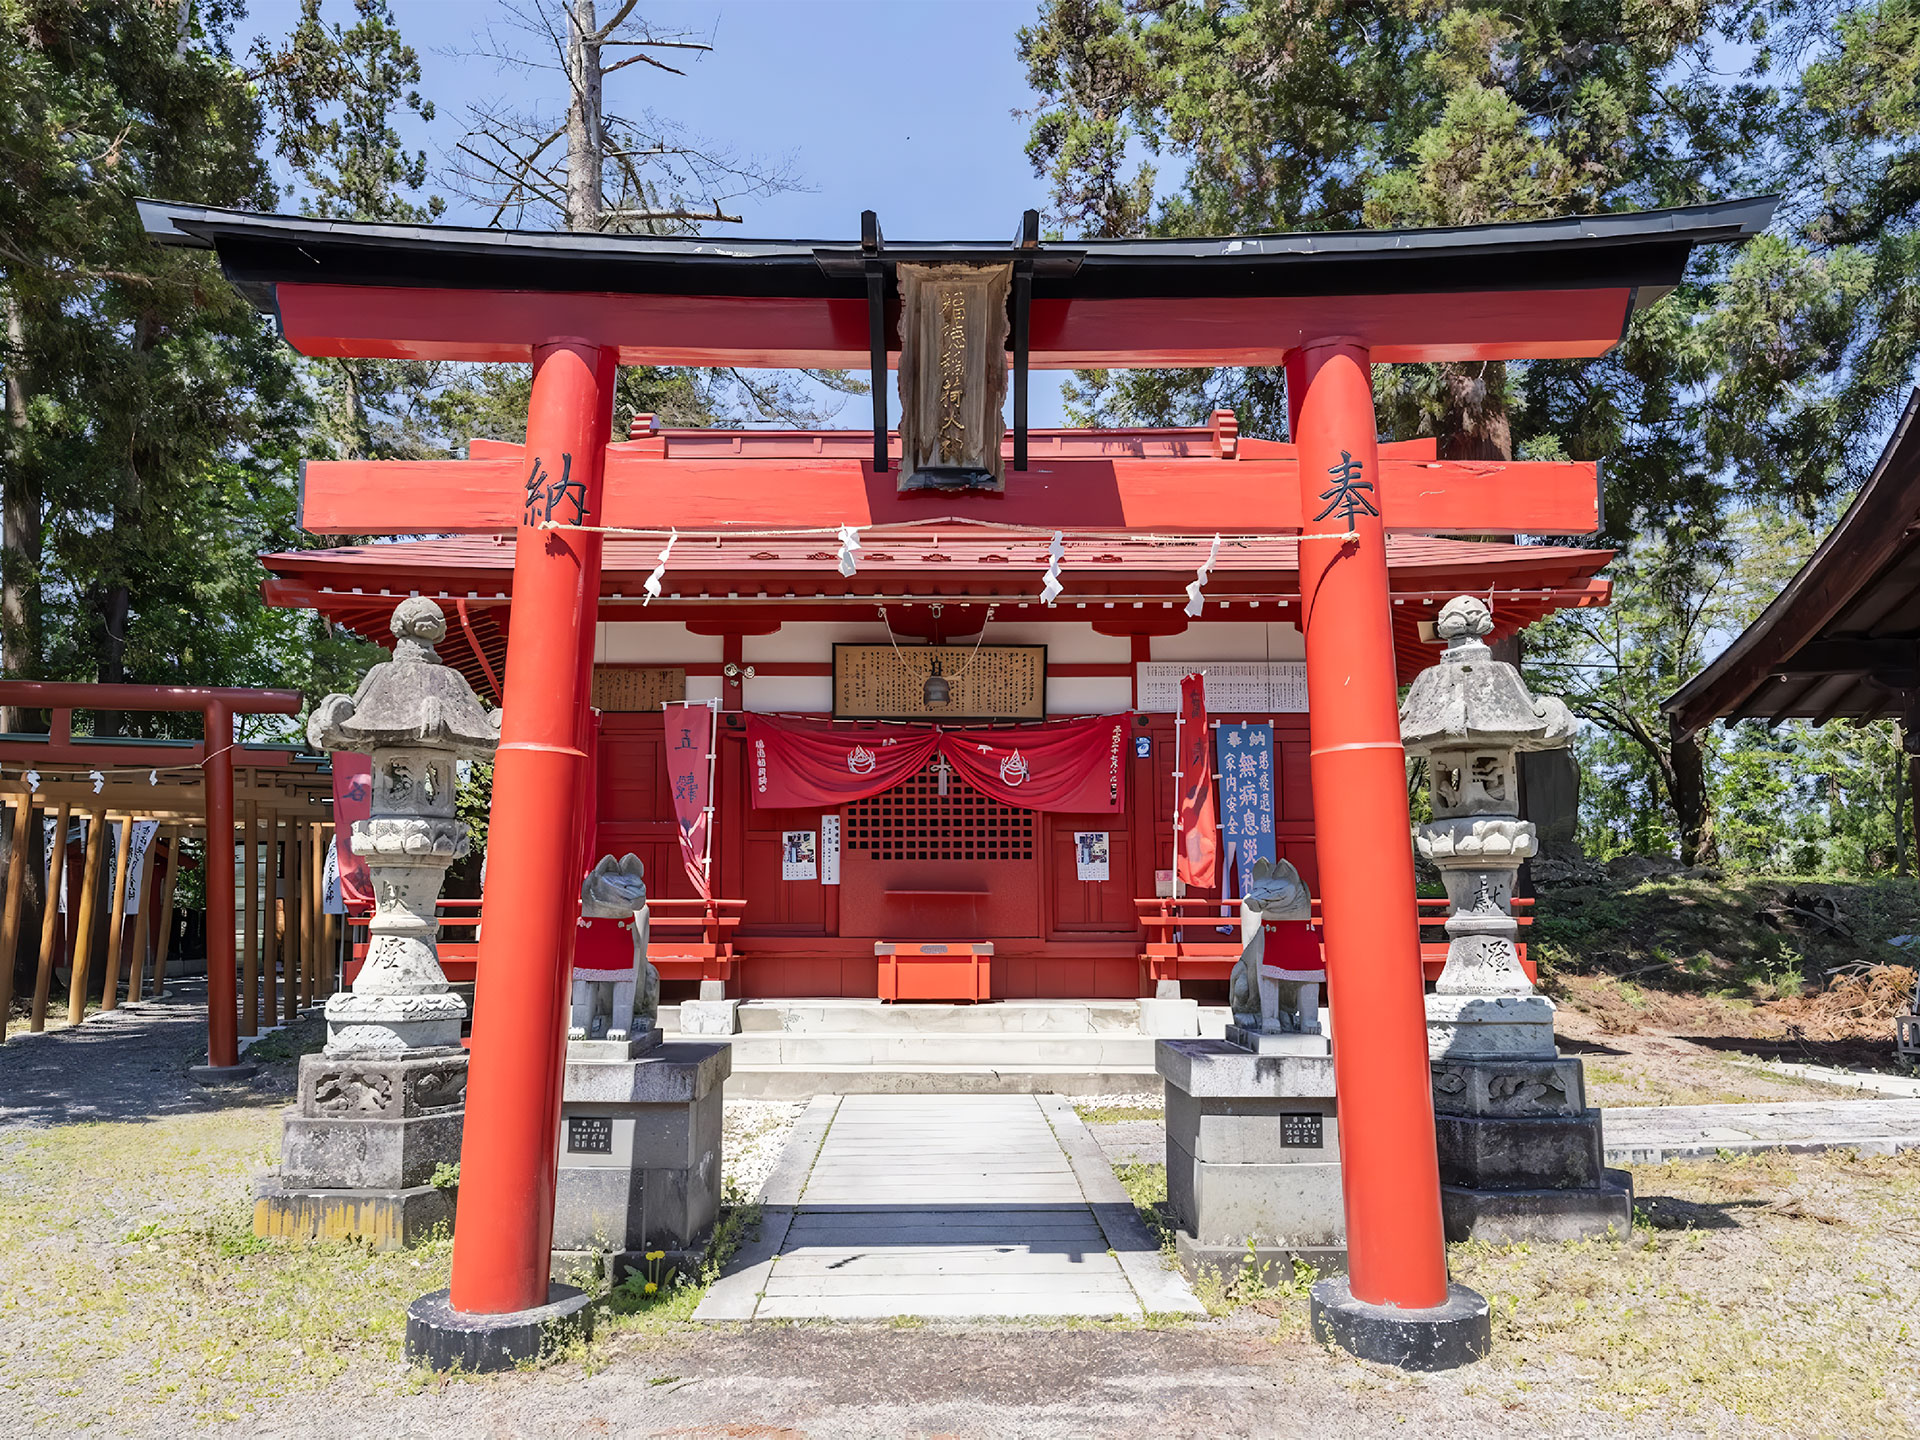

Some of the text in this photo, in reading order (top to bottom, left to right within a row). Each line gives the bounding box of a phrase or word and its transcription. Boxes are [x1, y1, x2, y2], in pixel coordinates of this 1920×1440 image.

[523, 453, 591, 527] 納
[1313, 450, 1379, 532] 奉
[1224, 752, 1239, 835] 家内安全
